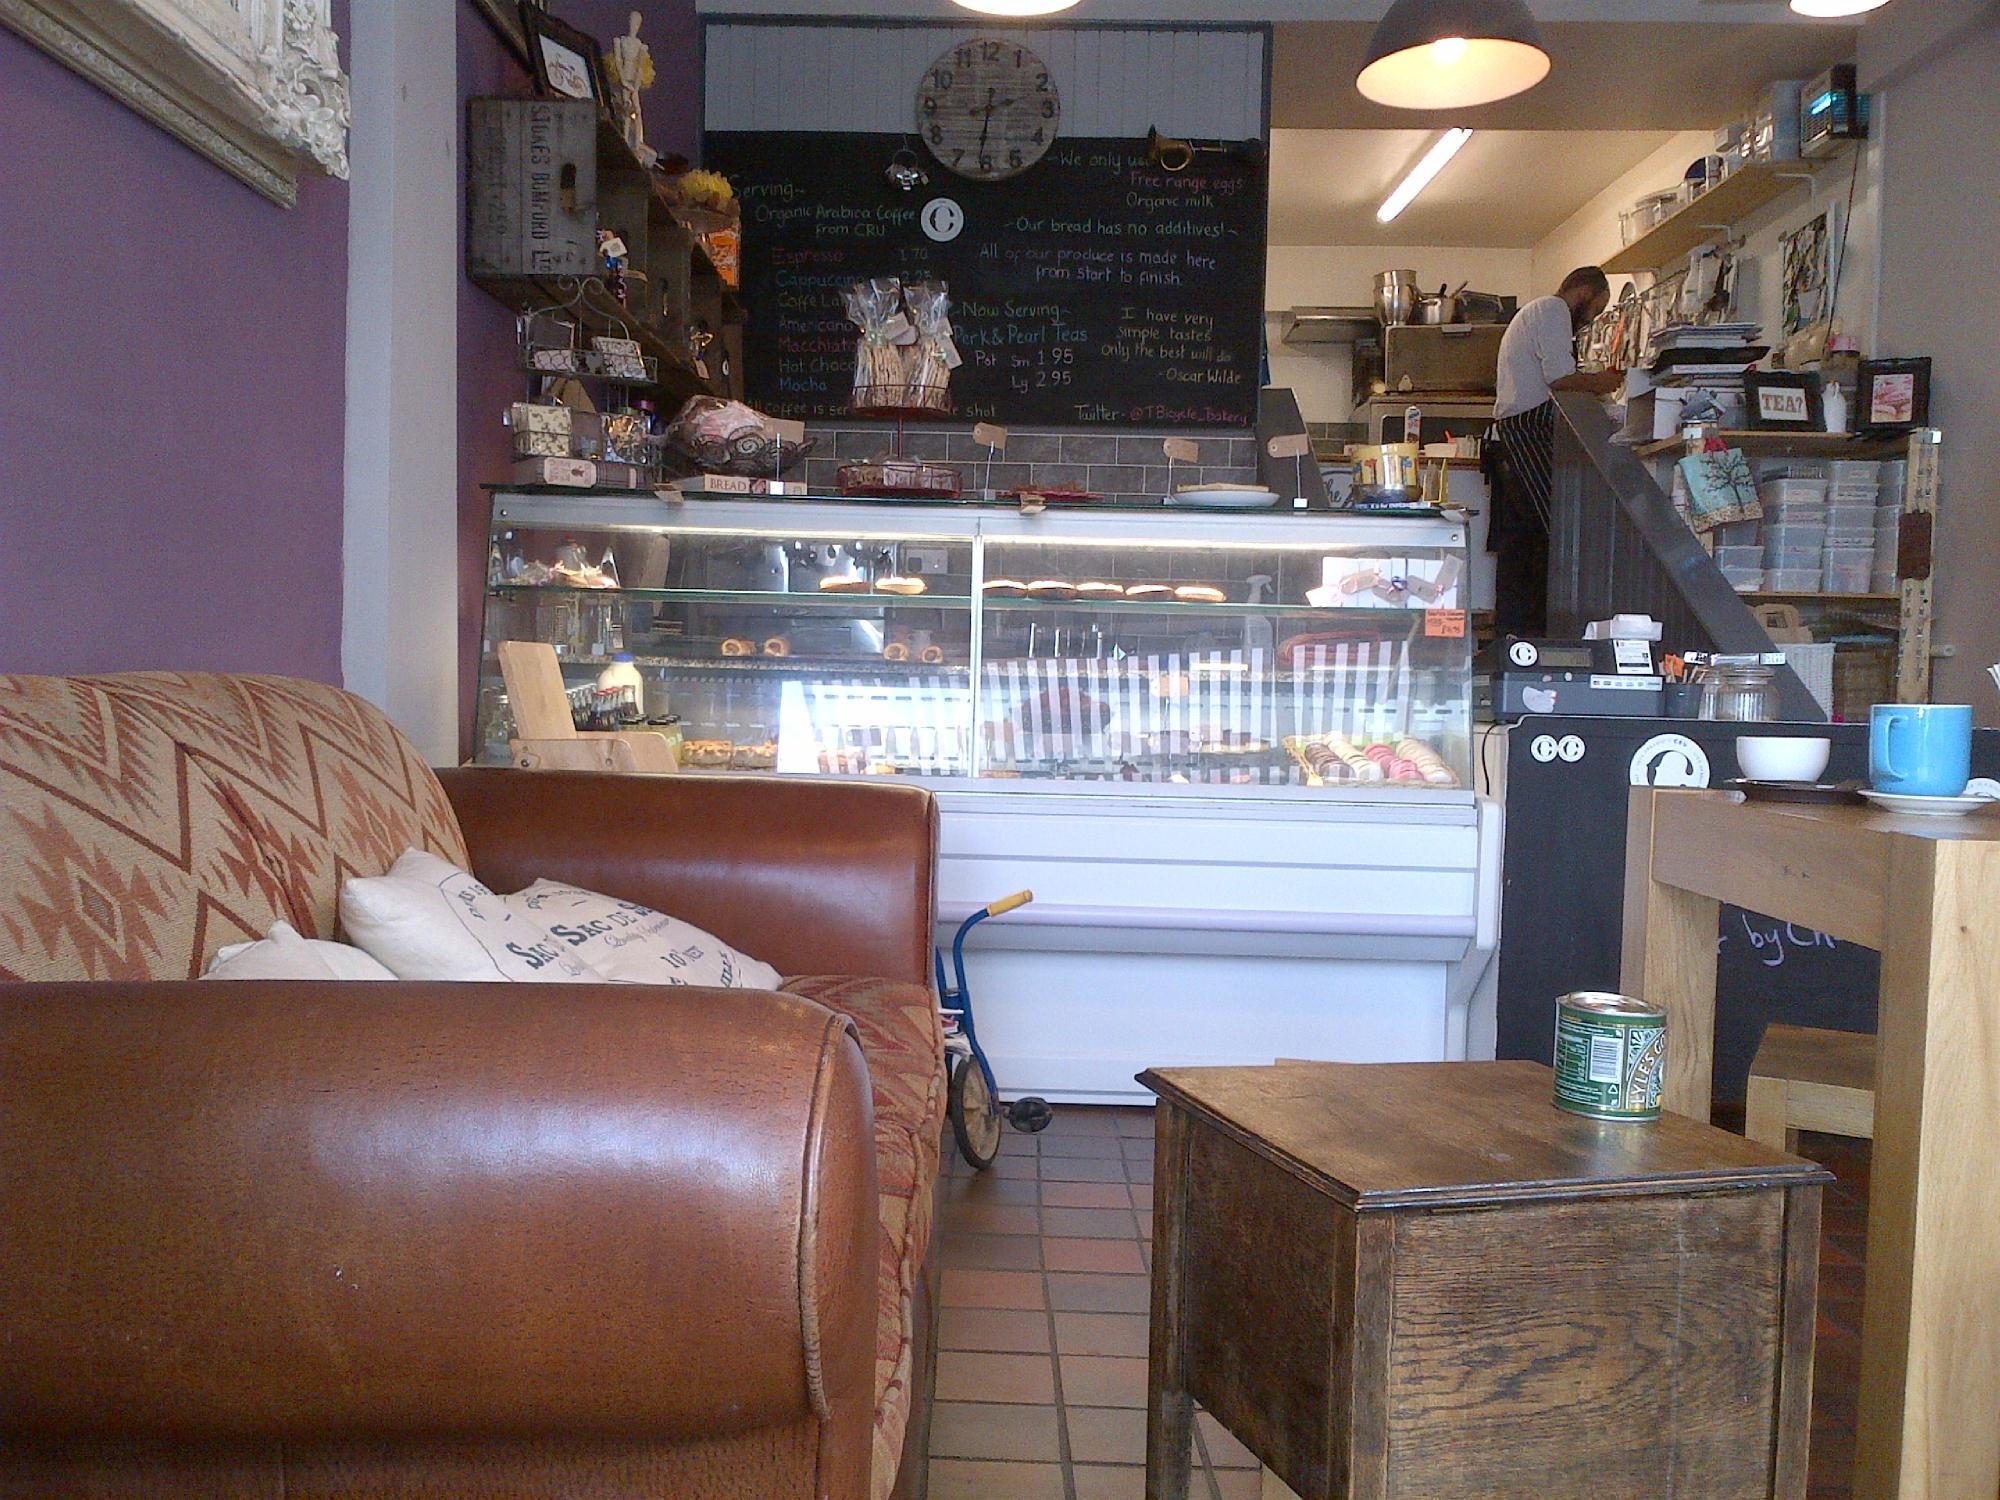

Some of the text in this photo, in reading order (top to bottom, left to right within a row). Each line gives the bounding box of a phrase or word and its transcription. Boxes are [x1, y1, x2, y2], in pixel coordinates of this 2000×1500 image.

[981, 41, 999, 62] 12
[930, 68, 953, 90] 10
[1036, 72, 1049, 92] 2
[923, 96, 937, 115] 9
[1041, 100, 1055, 119] 3
[930, 124, 943, 146] 8
[1031, 126, 1044, 146] 4
[952, 147, 965, 168] 7
[1089, 151, 1121, 175] only
[1130, 170, 1244, 195] Free range eggs
[1126, 191, 1215, 213] Organic milk
[755, 204, 915, 228] Organic Arabica Coffee
[854, 223, 885, 237] CRU
[1015, 216, 1225, 238] Our bread has no additives!
[979, 243, 1217, 270] All of our produce is made here
[1035, 264, 1070, 282] from
[1077, 265, 1112, 282] start
[1120, 267, 1133, 283] to
[962, 299, 1061, 322] Now Serving
[1121, 306, 1215, 330] I have very
[1007, 323, 1046, 344] Pearl
[1050, 322, 1089, 342] Teas
[975, 350, 997, 367] Pot
[1135, 342, 1154, 358] the
[1160, 343, 1186, 360] best
[1191, 345, 1213, 362] will
[1216, 350, 1232, 362] do
[778, 358, 803, 373] Hot
[779, 376, 828, 392] Mocha
[1207, 369, 1242, 385] Wilde
[966, 402, 996, 417] shot
[1761, 393, 1803, 413] TEA?
[710, 478, 747, 492] BREAD
[1741, 912, 1785, 967] by
[1630, 1051, 1655, 1104] LYLE'S
